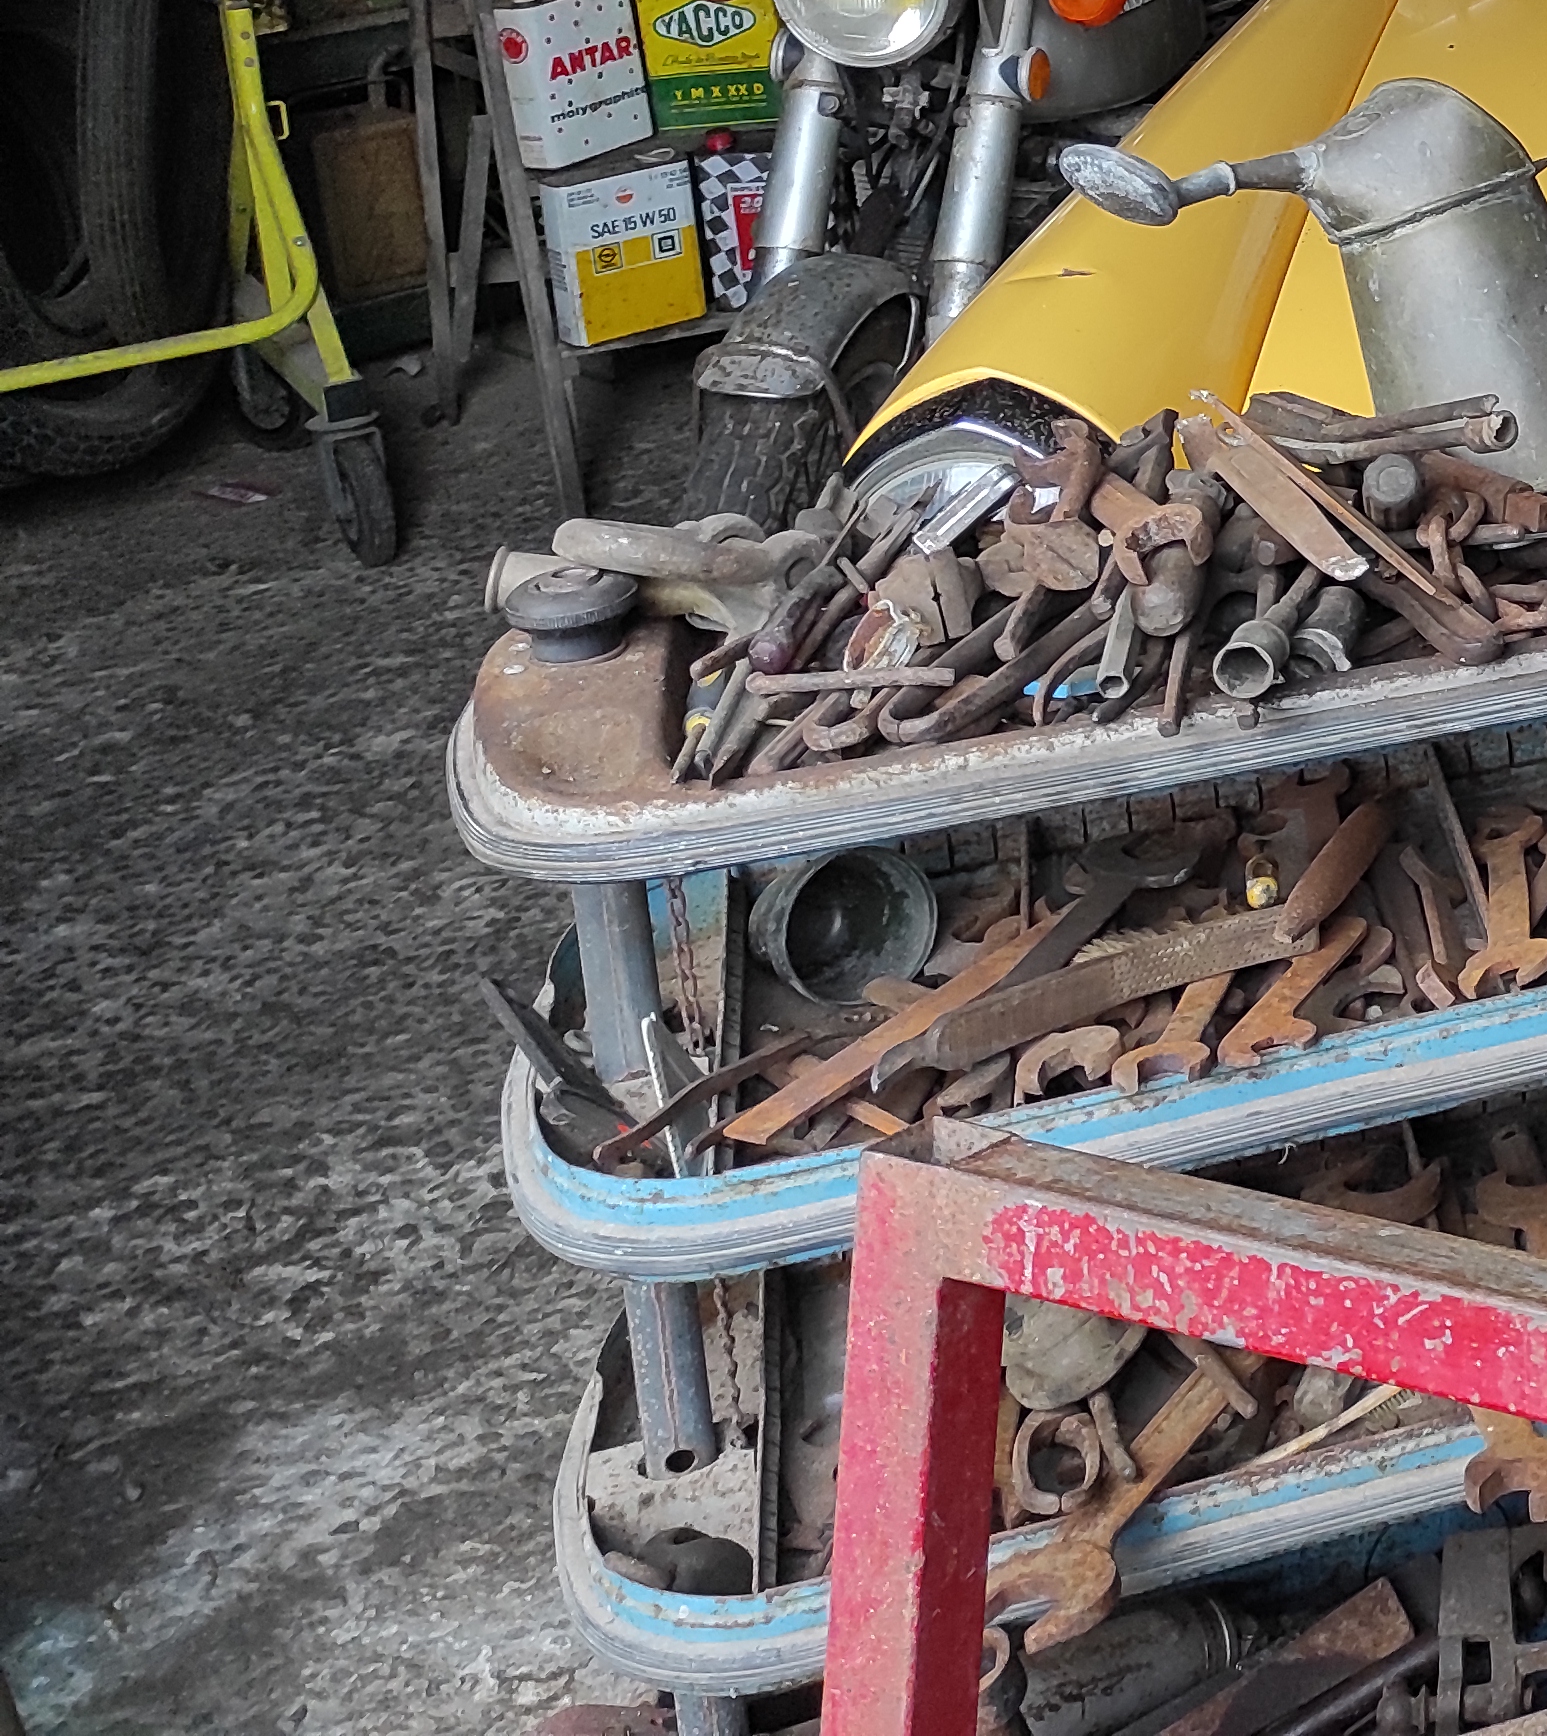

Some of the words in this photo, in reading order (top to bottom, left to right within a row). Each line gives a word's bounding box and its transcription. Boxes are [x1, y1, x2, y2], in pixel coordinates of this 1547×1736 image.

[660, 2, 746, 44] YACCO
[549, 36, 631, 81] ANTAR
[590, 221, 620, 240] SAE
[659, 207, 677, 224] 50
